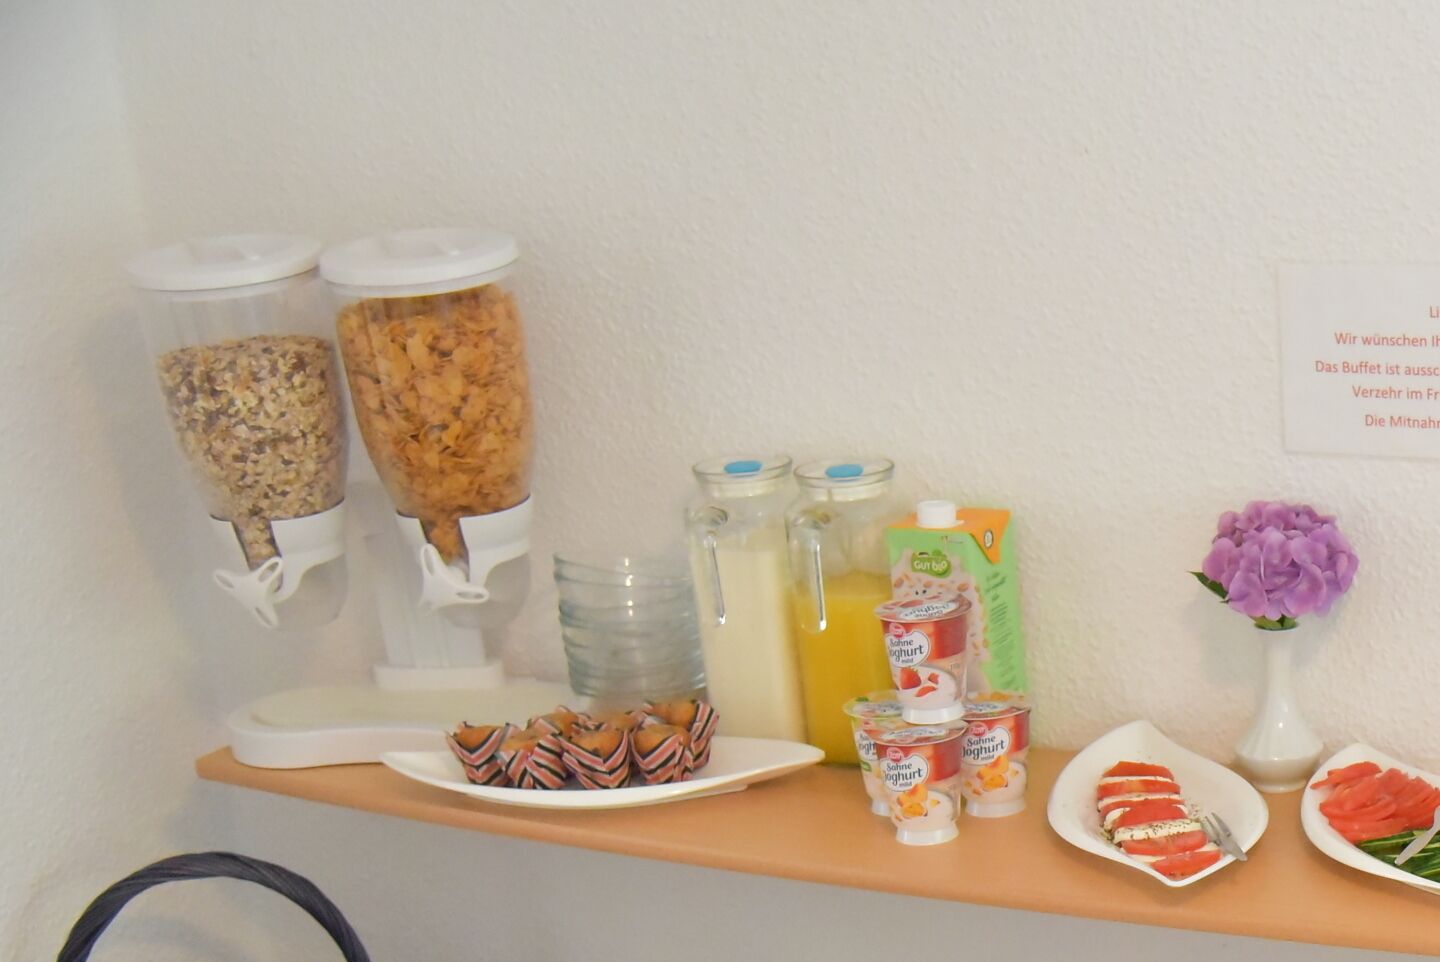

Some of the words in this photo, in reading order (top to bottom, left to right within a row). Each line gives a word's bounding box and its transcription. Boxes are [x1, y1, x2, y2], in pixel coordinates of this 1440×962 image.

[1334, 332, 1357, 345] Wir
[1361, 333, 1427, 348] wünschen
[1315, 360, 1338, 373] Das
[1342, 361, 1382, 375] Buffet
[1385, 363, 1400, 375] ist
[1352, 384, 1402, 399] Verzehr
[1406, 386, 1422, 400] im
[1365, 414, 1386, 428] Die
[889, 638, 914, 648] Sahne
[967, 736, 996, 747] Sahne
[886, 762, 912, 772] Sahne
